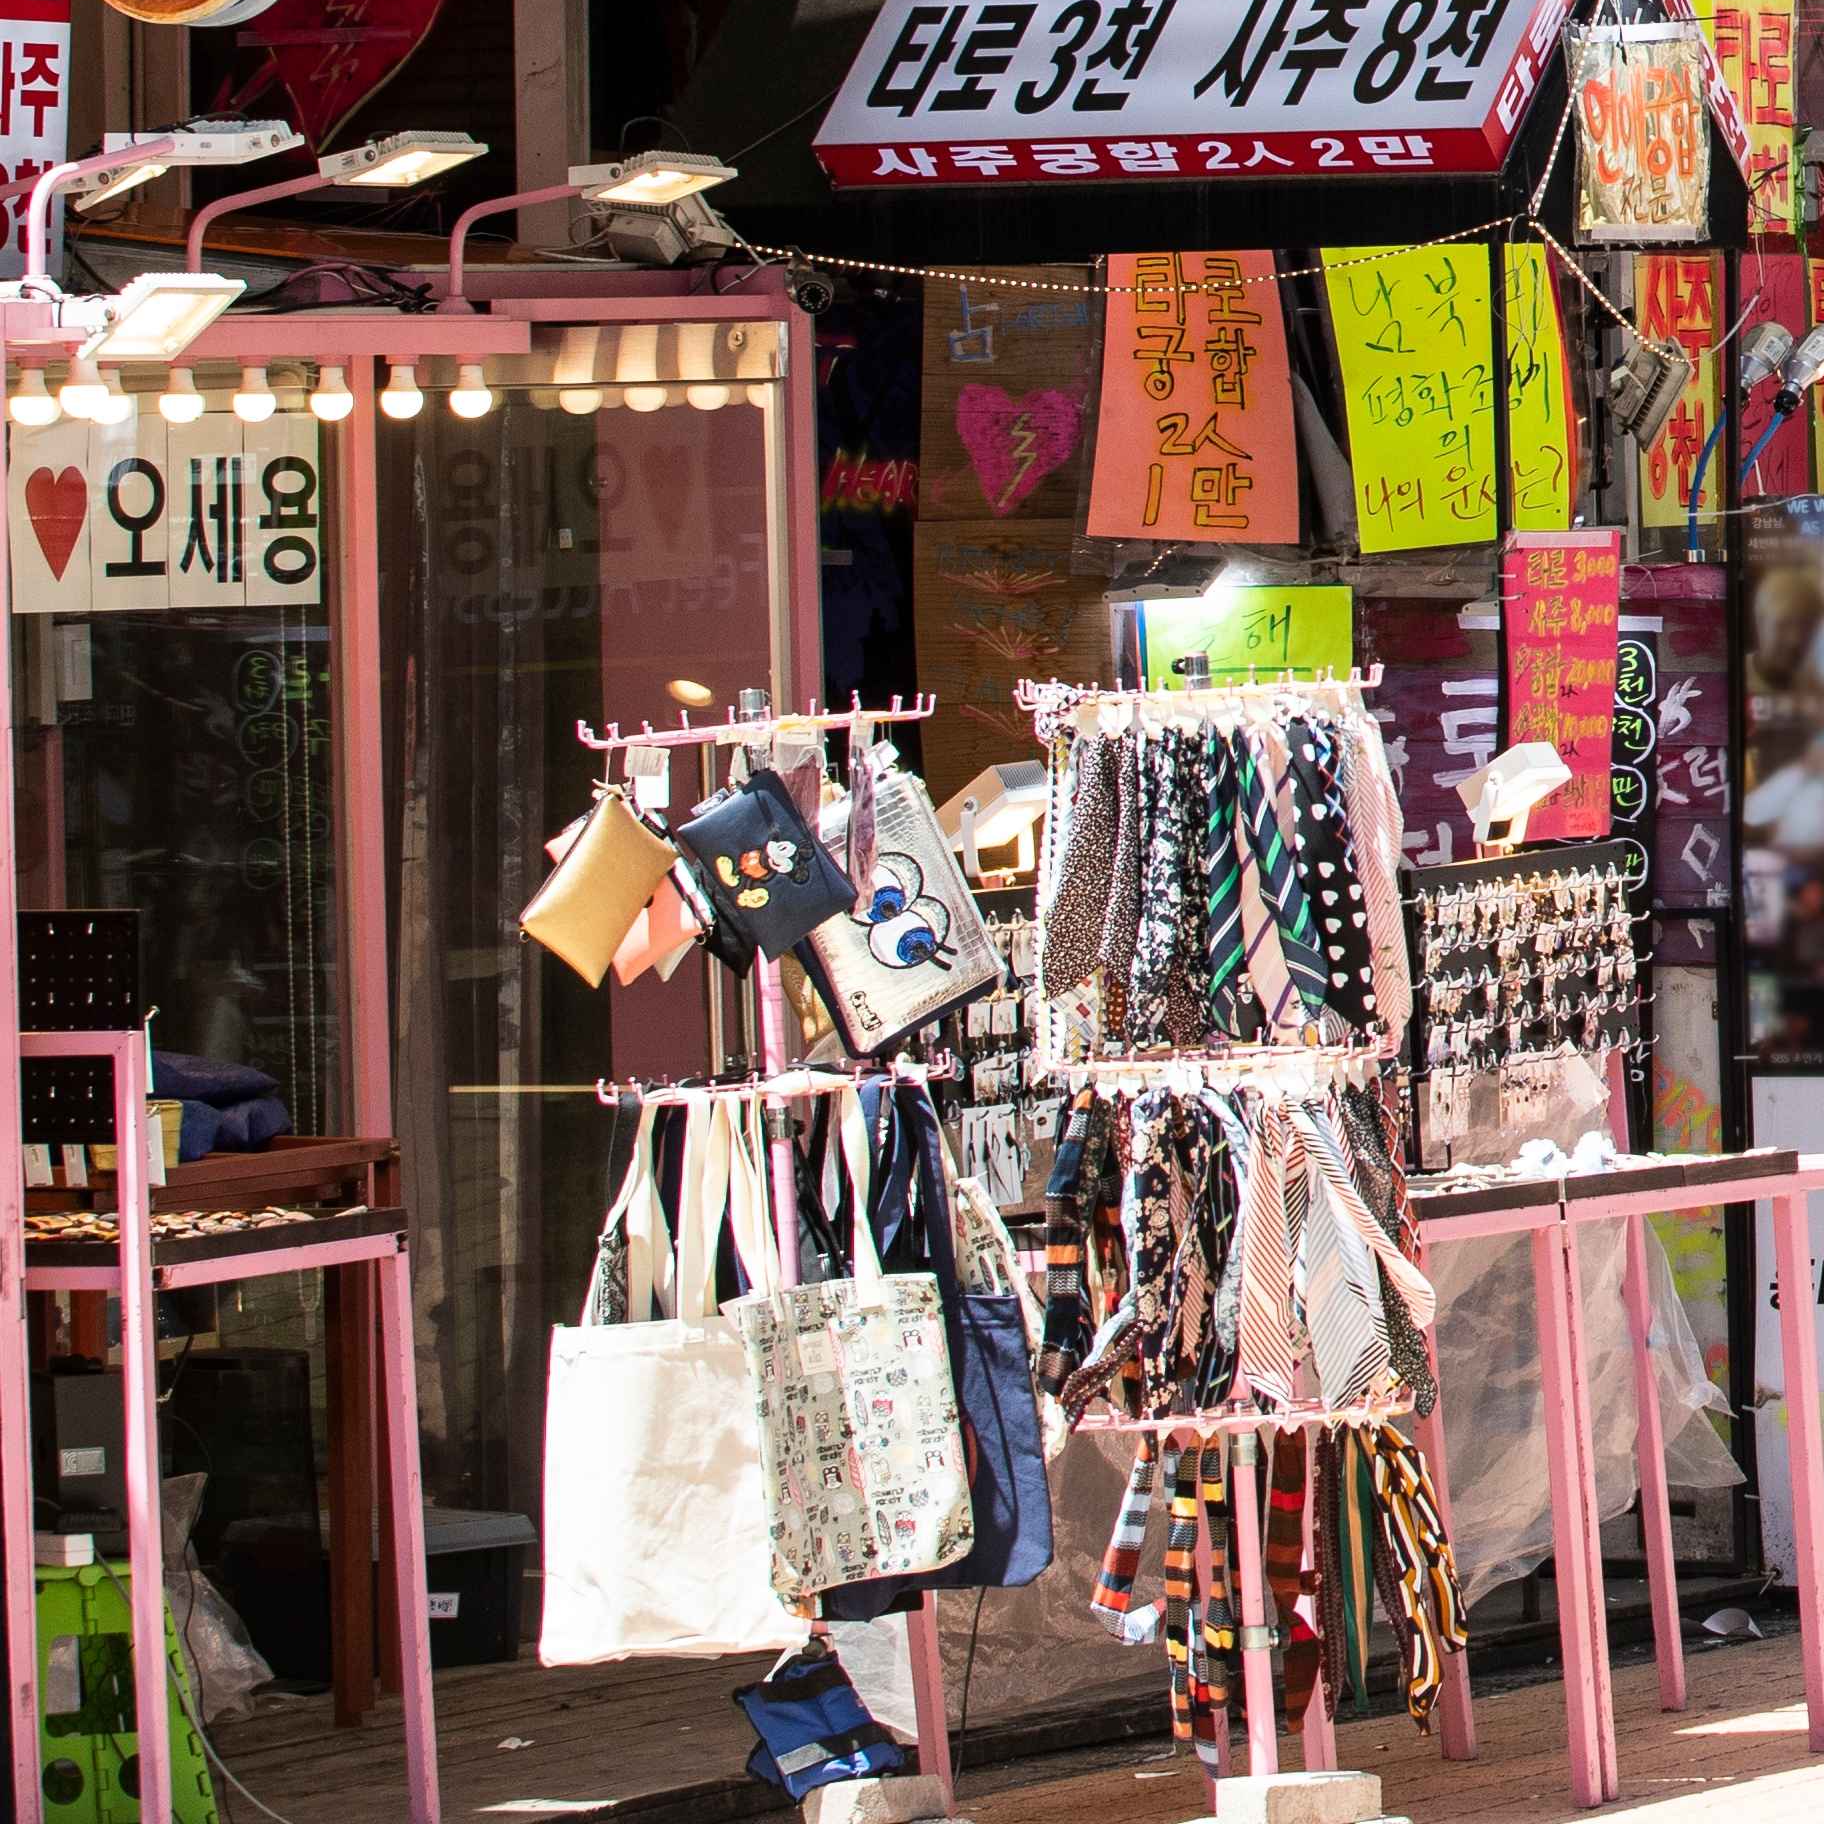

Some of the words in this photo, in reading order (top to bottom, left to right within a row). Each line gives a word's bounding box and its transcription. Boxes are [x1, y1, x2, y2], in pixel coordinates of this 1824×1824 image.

[1714, 7, 1792, 129] 타로
[1316, 135, 1436, 169] 2만
[1134, 251, 1264, 326] 타로
[1133, 327, 1256, 411] 궁합
[105, 454, 320, 585] 오세용
[1365, 477, 1424, 533] 나의
[1786, 499, 1809, 514] WE
[1801, 521, 1821, 534] AS
[1527, 549, 1566, 589] 타로
[1530, 597, 1565, 638] 사주
